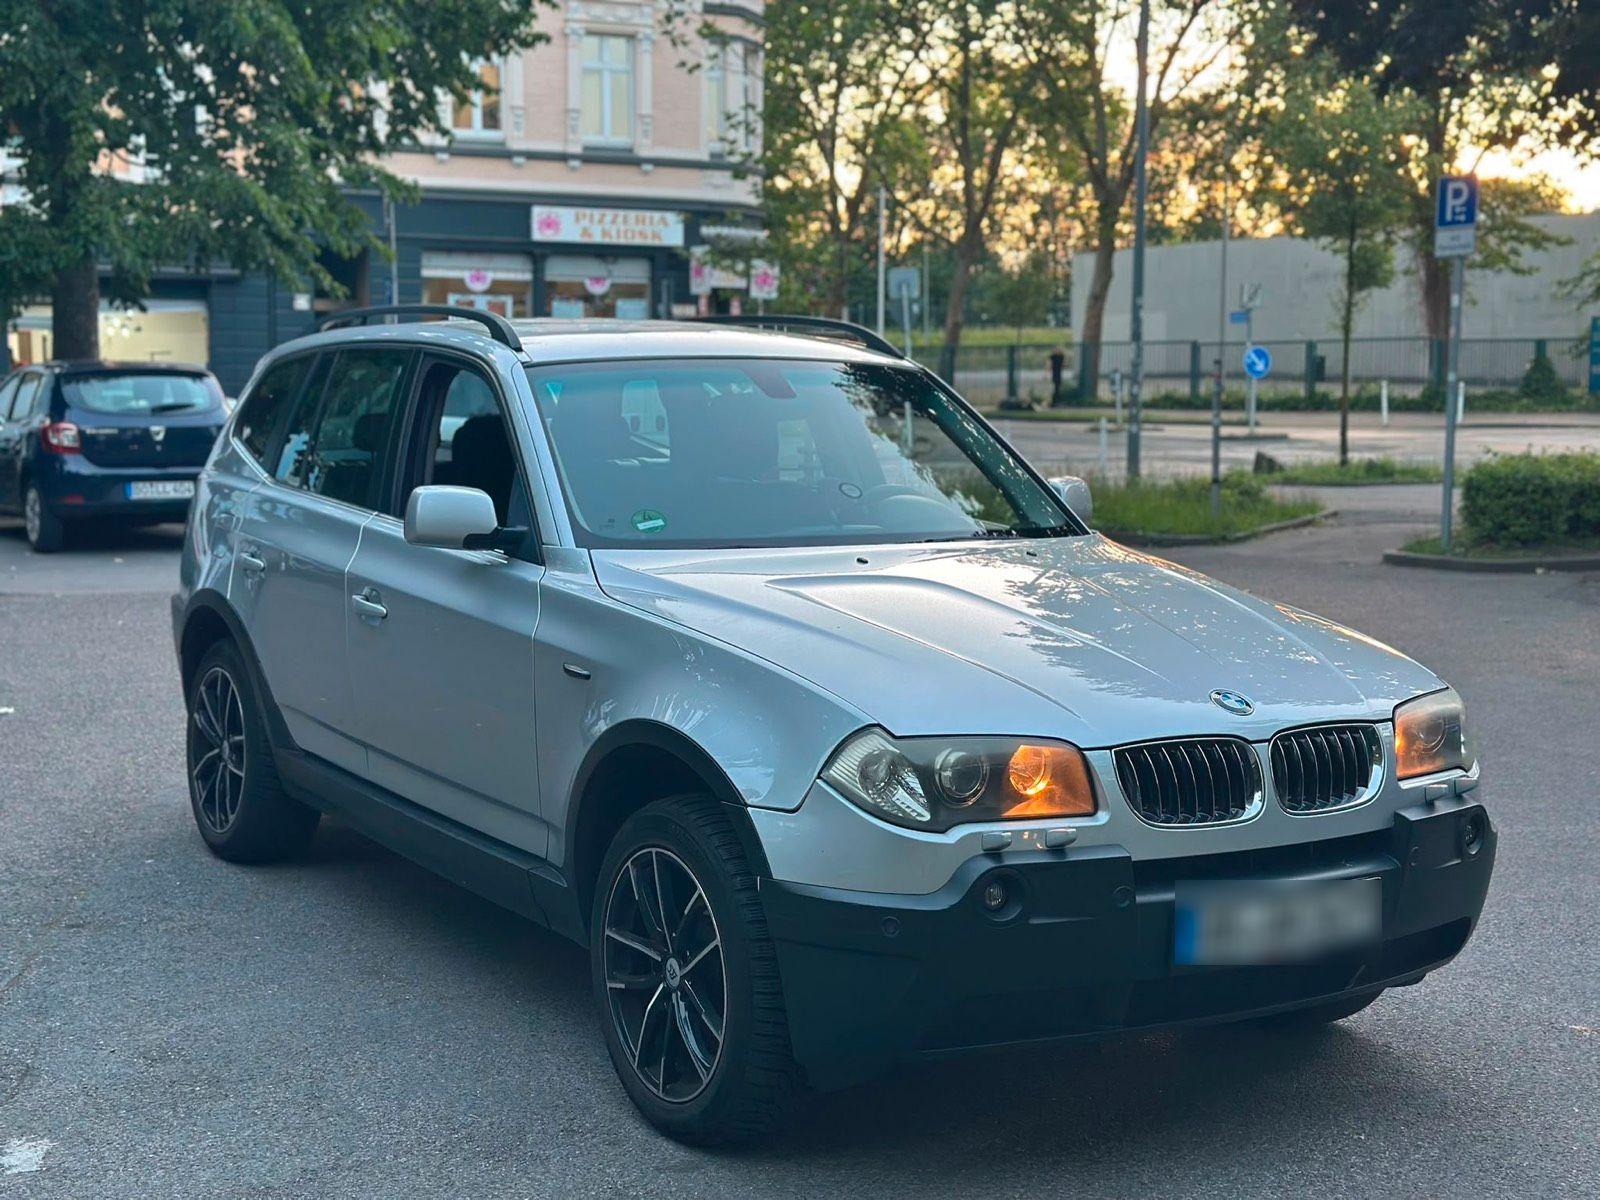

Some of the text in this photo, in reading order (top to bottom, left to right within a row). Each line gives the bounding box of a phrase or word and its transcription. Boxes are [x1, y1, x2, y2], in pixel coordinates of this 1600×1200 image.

[1446, 181, 1469, 222] P
[575, 211, 669, 227] PIZZERIA
[580, 227, 662, 242] & KIOSK
